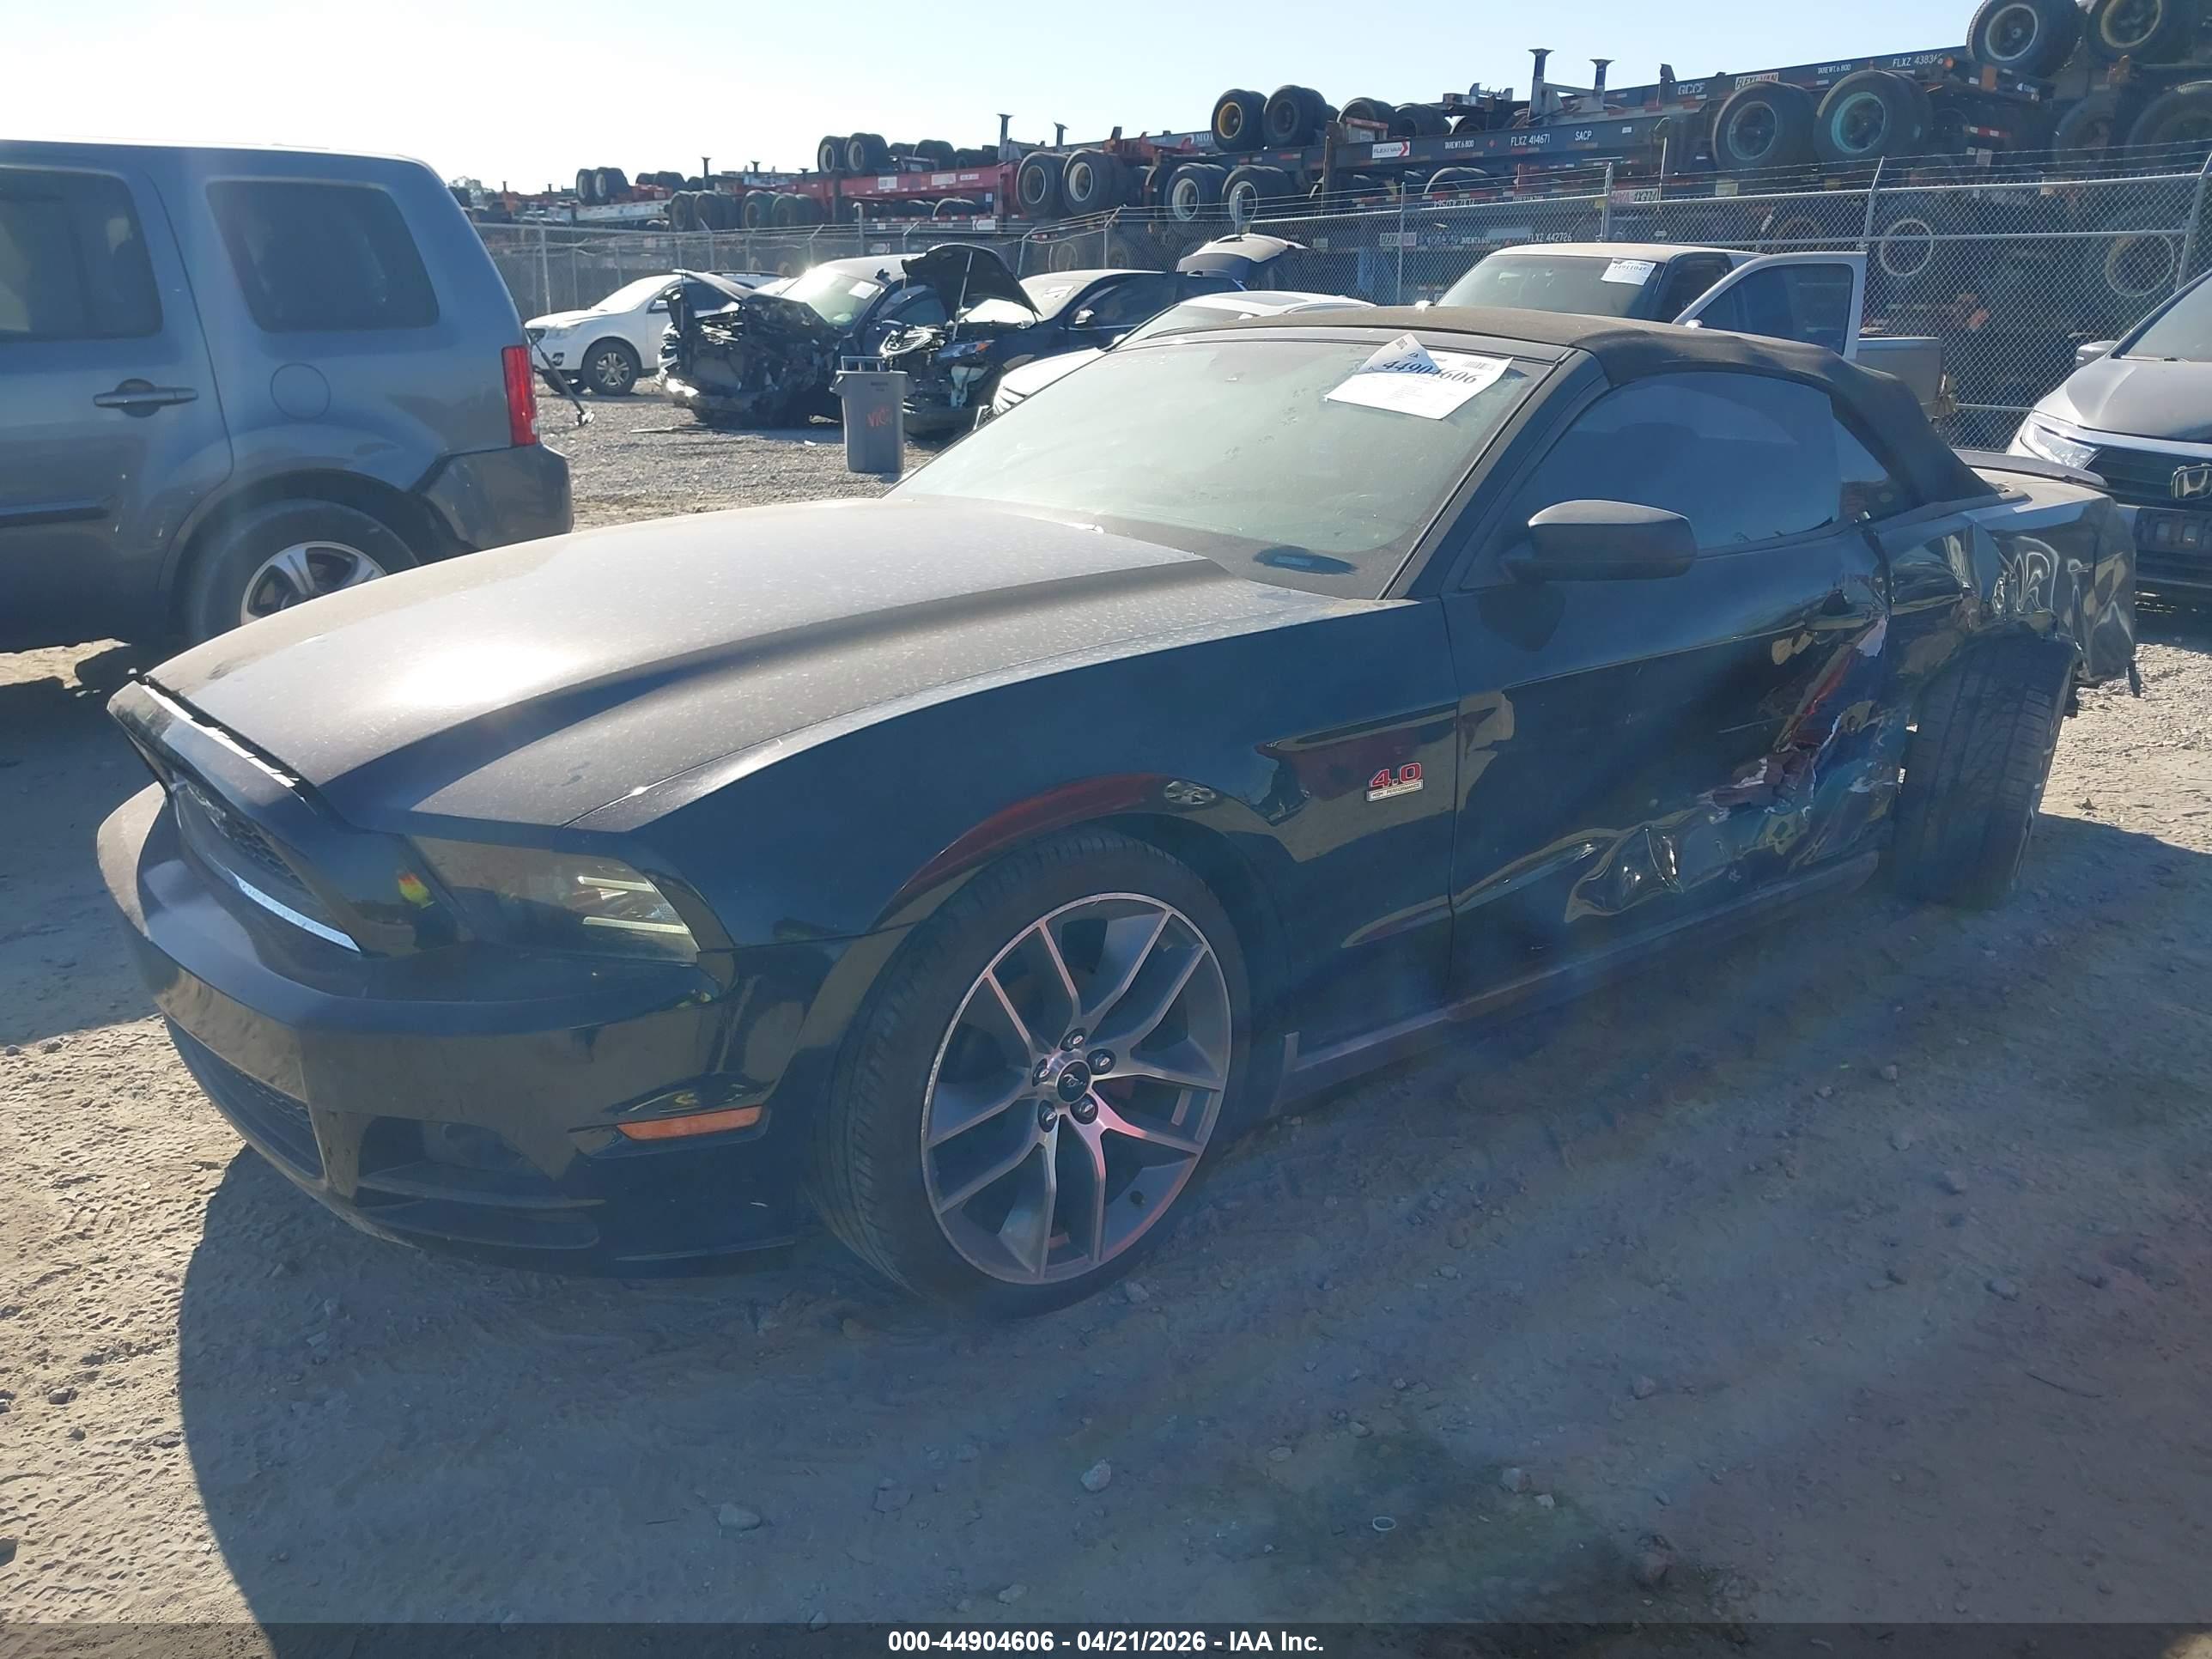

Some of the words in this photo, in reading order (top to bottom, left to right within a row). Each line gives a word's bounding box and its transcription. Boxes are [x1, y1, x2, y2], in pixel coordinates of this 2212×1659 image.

[1510, 136, 1528, 147] FLXZ
[1528, 133, 1551, 145] 414671
[1574, 130, 1593, 142] SACP
[1382, 360, 1479, 384] 44904606
[1370, 763, 1422, 787] 4.0
